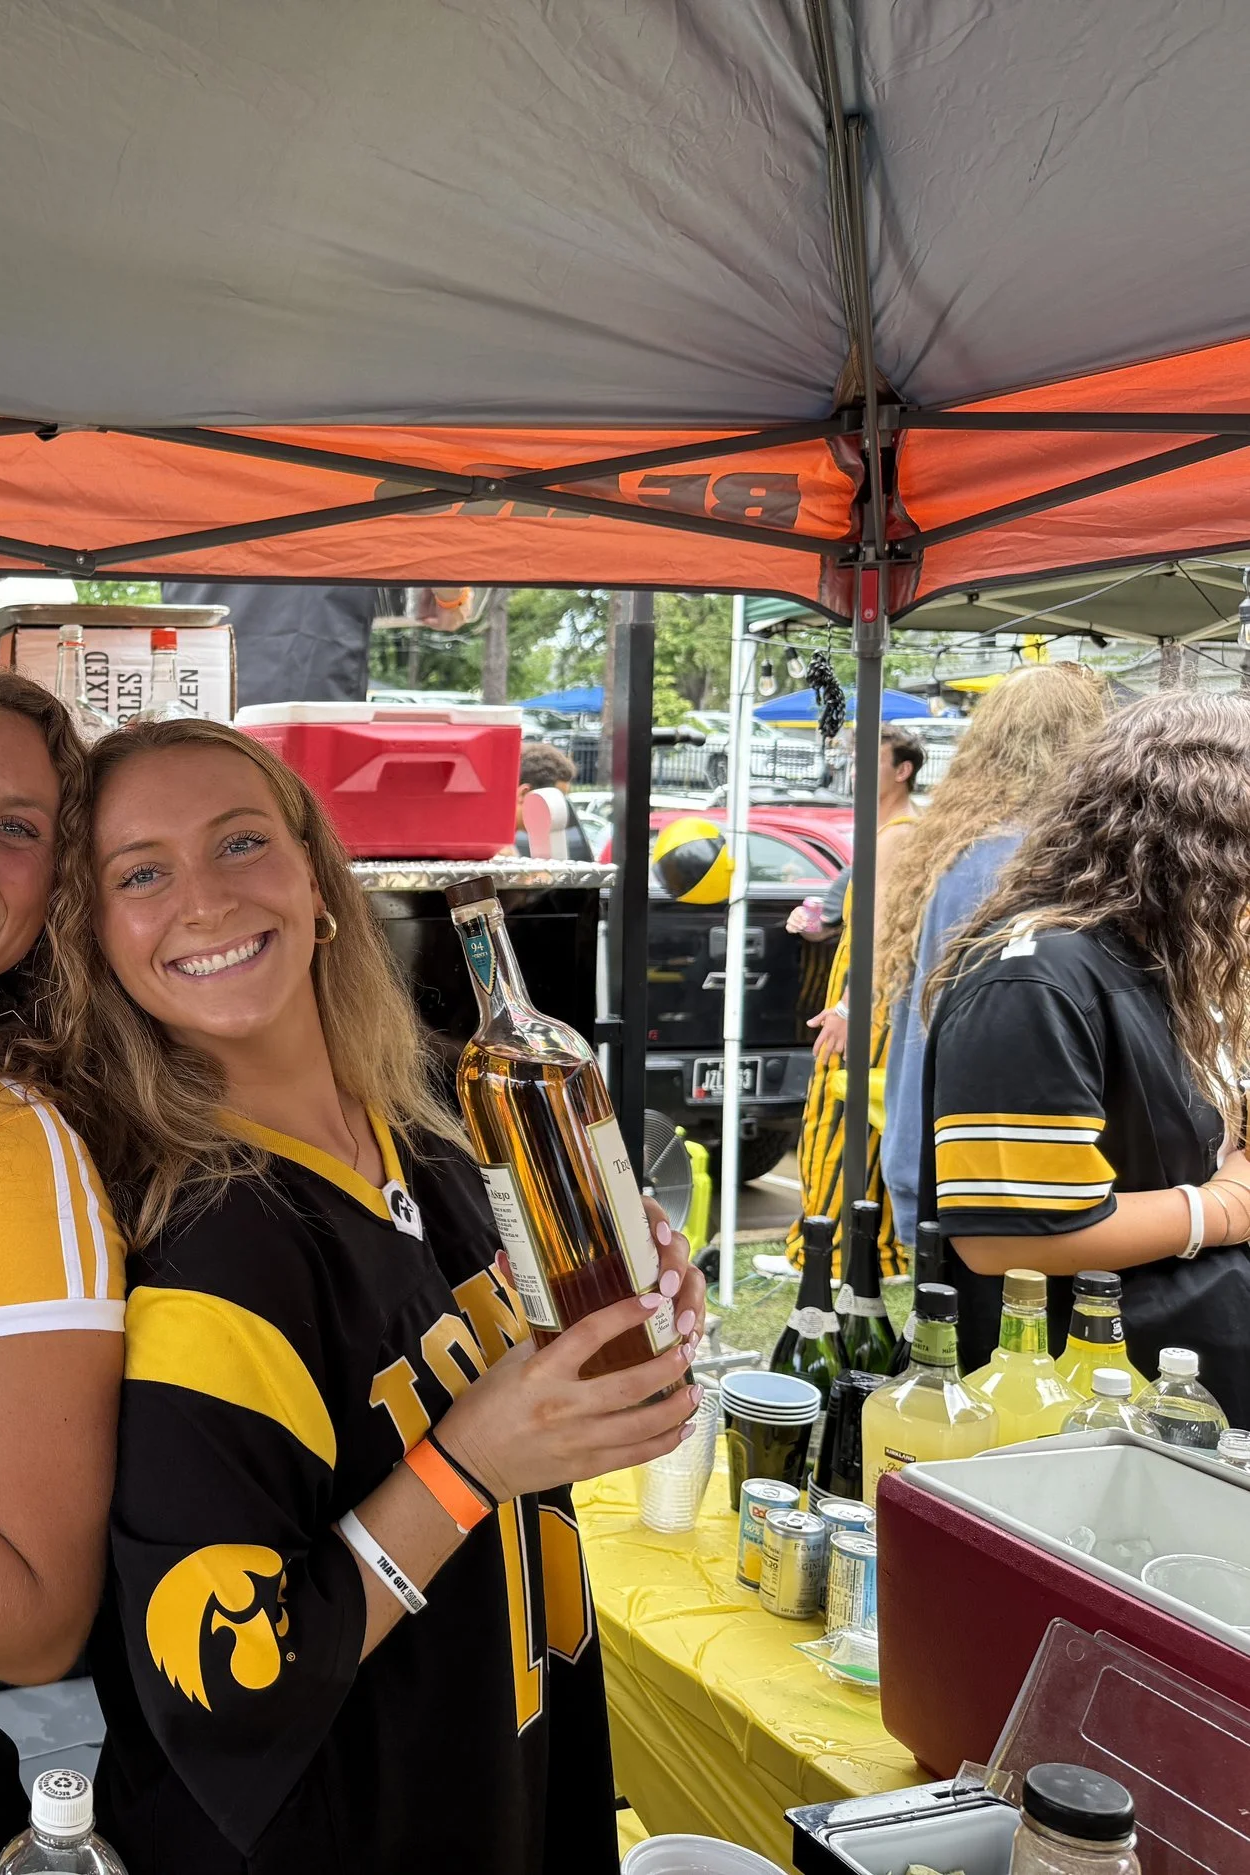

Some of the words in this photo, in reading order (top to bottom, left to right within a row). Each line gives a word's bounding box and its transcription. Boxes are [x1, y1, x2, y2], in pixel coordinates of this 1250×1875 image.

[470, 941, 485, 952] 94
[376, 1555, 397, 1578] THAT
[393, 1576, 409, 1594] GUY.
